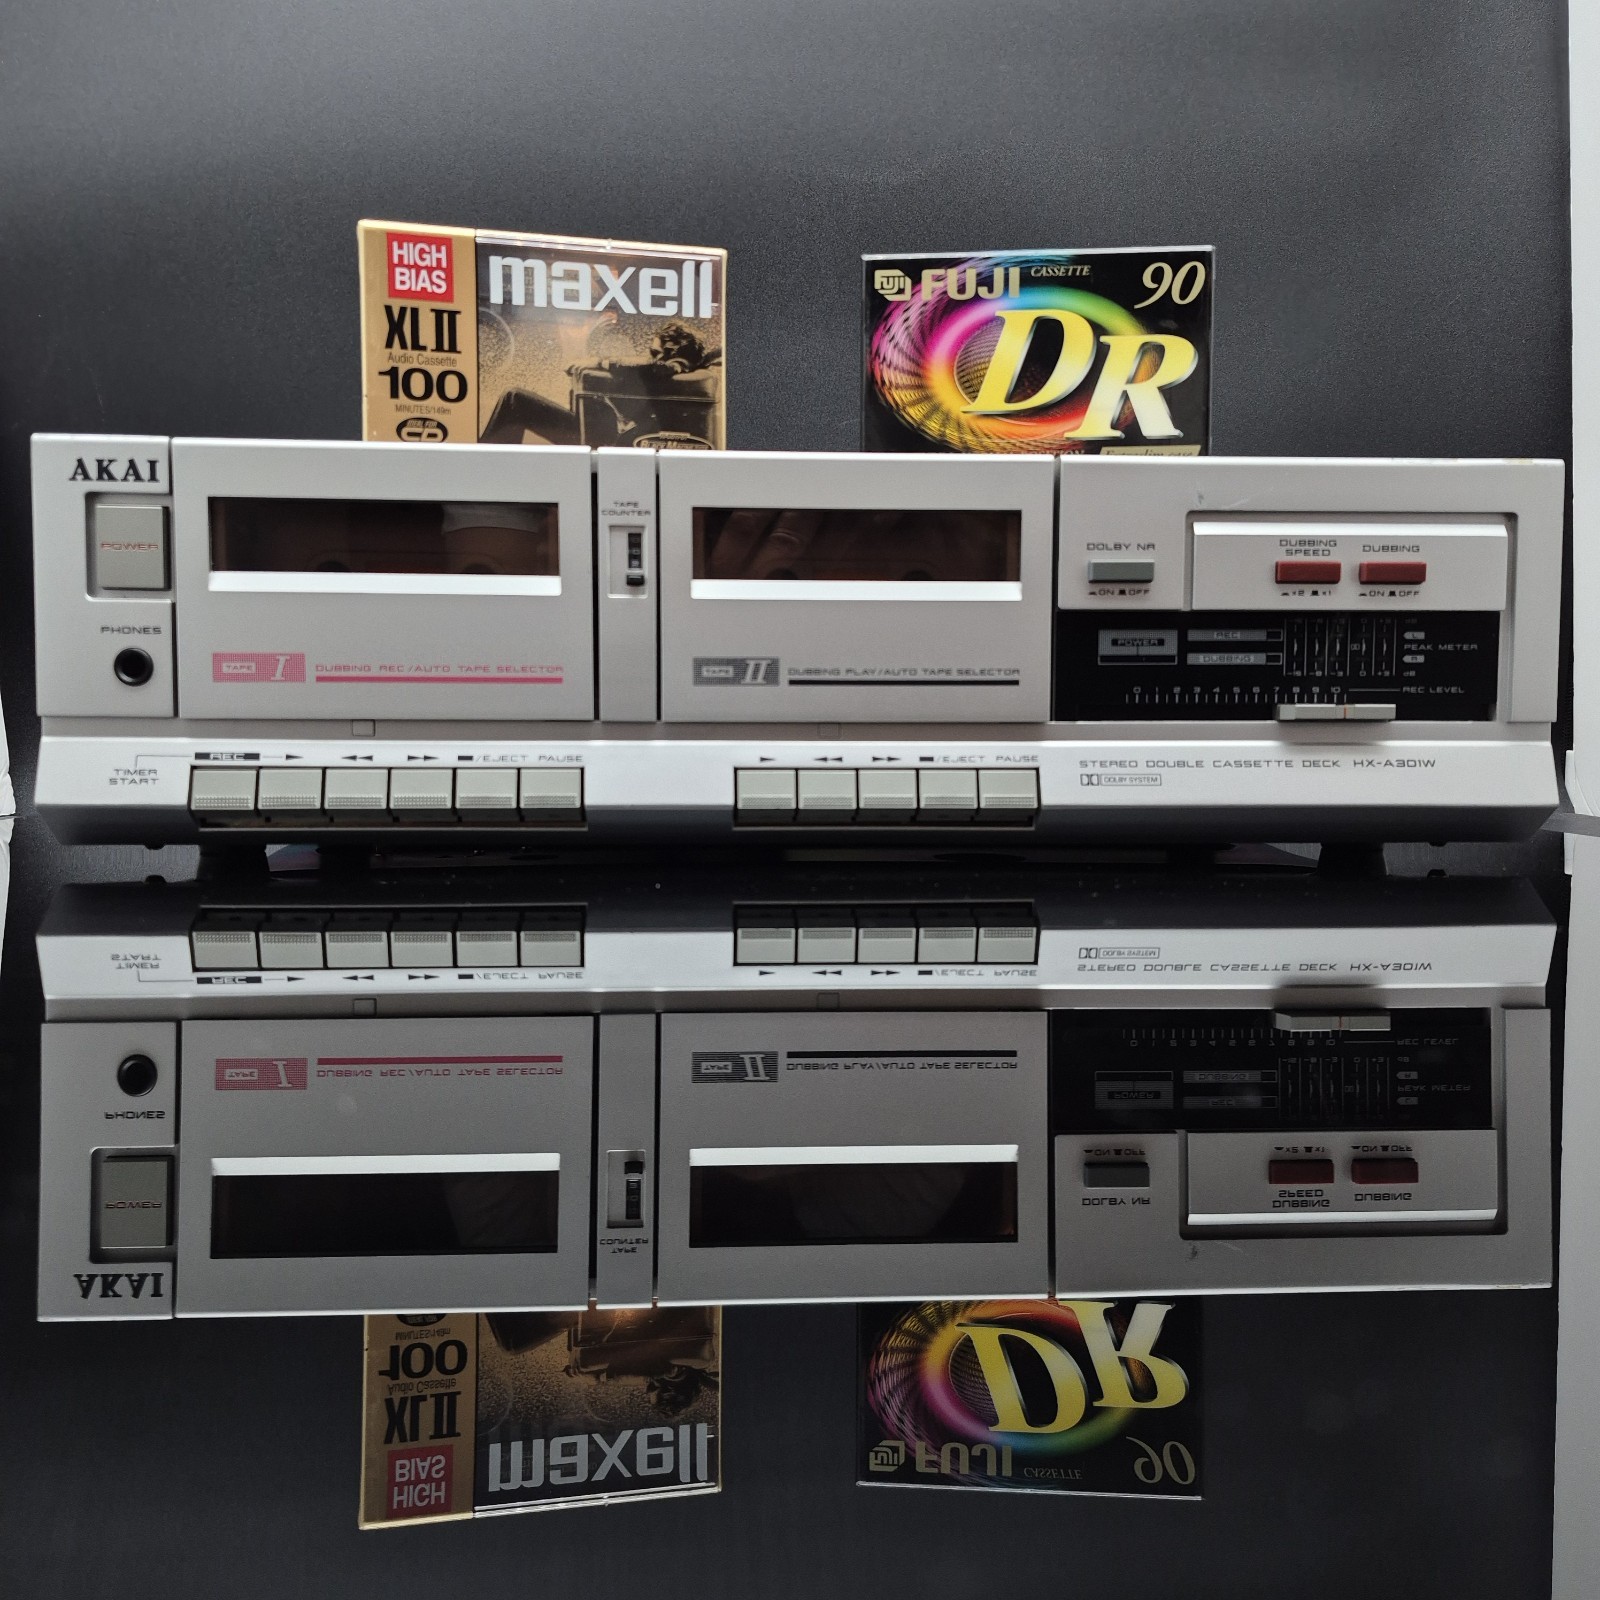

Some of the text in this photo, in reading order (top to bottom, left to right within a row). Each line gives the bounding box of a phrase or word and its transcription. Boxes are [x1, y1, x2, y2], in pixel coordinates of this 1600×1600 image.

[392, 241, 447, 268] HIGH
[1030, 265, 1091, 278] CASSETTE
[394, 267, 447, 294] BIAS
[922, 267, 1020, 300] FUJI
[1134, 260, 1206, 309] 90
[488, 255, 713, 318] maxell
[388, 352, 457, 368] Audio Cassette
[960, 309, 1199, 440] DR
[378, 367, 468, 403] 100
[69, 458, 160, 482] AKAI
[101, 543, 158, 551] POWER
[1279, 539, 1336, 547] DUBBING
[1362, 544, 1420, 552] DUBBING
[1099, 588, 1150, 596] ON OFF
[101, 626, 162, 635] PHONES
[1214, 632, 1240, 640] REC
[316, 664, 371, 672] DUBBING
[380, 664, 450, 673] REC/AUTO
[457, 665, 490, 673] TAPE
[788, 668, 840, 676] DUBBING
[845, 668, 917, 676] PLAY/AUTO
[922, 668, 952, 676] TAPE
[957, 668, 1020, 676] SELECTOR
[1133, 686, 1142, 694] 0
[1173, 686, 1180, 694] 2
[1193, 686, 1200, 694] 3
[1212, 686, 1220, 694] 4
[1273, 686, 1280, 694] 7
[1330, 686, 1340, 694] 10
[1402, 686, 1464, 694] REC LEVEL
[996, 755, 1038, 763] PAUSE
[1079, 759, 1436, 768] STEREO DOUBLE CASSETTE DECK HX-A301W
[109, 768, 160, 786] TIMER START
